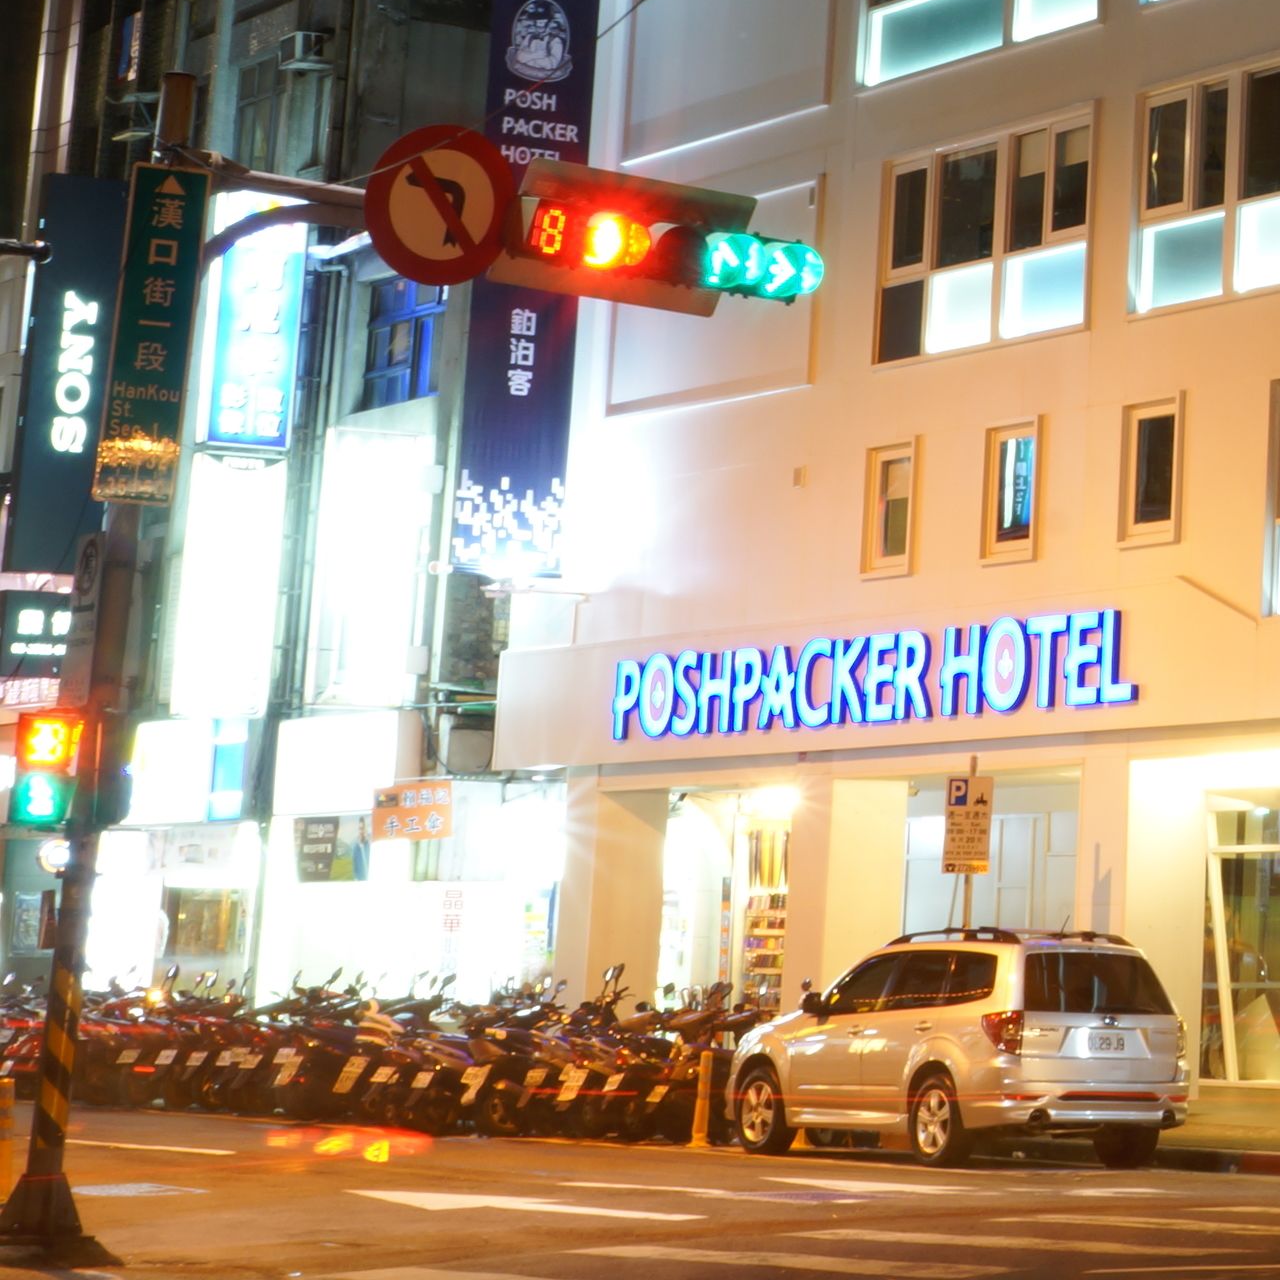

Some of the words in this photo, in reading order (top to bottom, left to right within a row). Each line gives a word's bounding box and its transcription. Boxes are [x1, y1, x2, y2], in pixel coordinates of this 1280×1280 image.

[502, 116, 580, 143] PACKER
[504, 88, 557, 112] POSH
[134, 198, 186, 372] 漢口街一段
[51, 290, 99, 454] SONY
[113, 381, 180, 402] HanKou
[507, 307, 537, 396] 鉑泊客
[612, 630, 933, 740] POSHPACKER
[939, 608, 1139, 718] HOTEL
